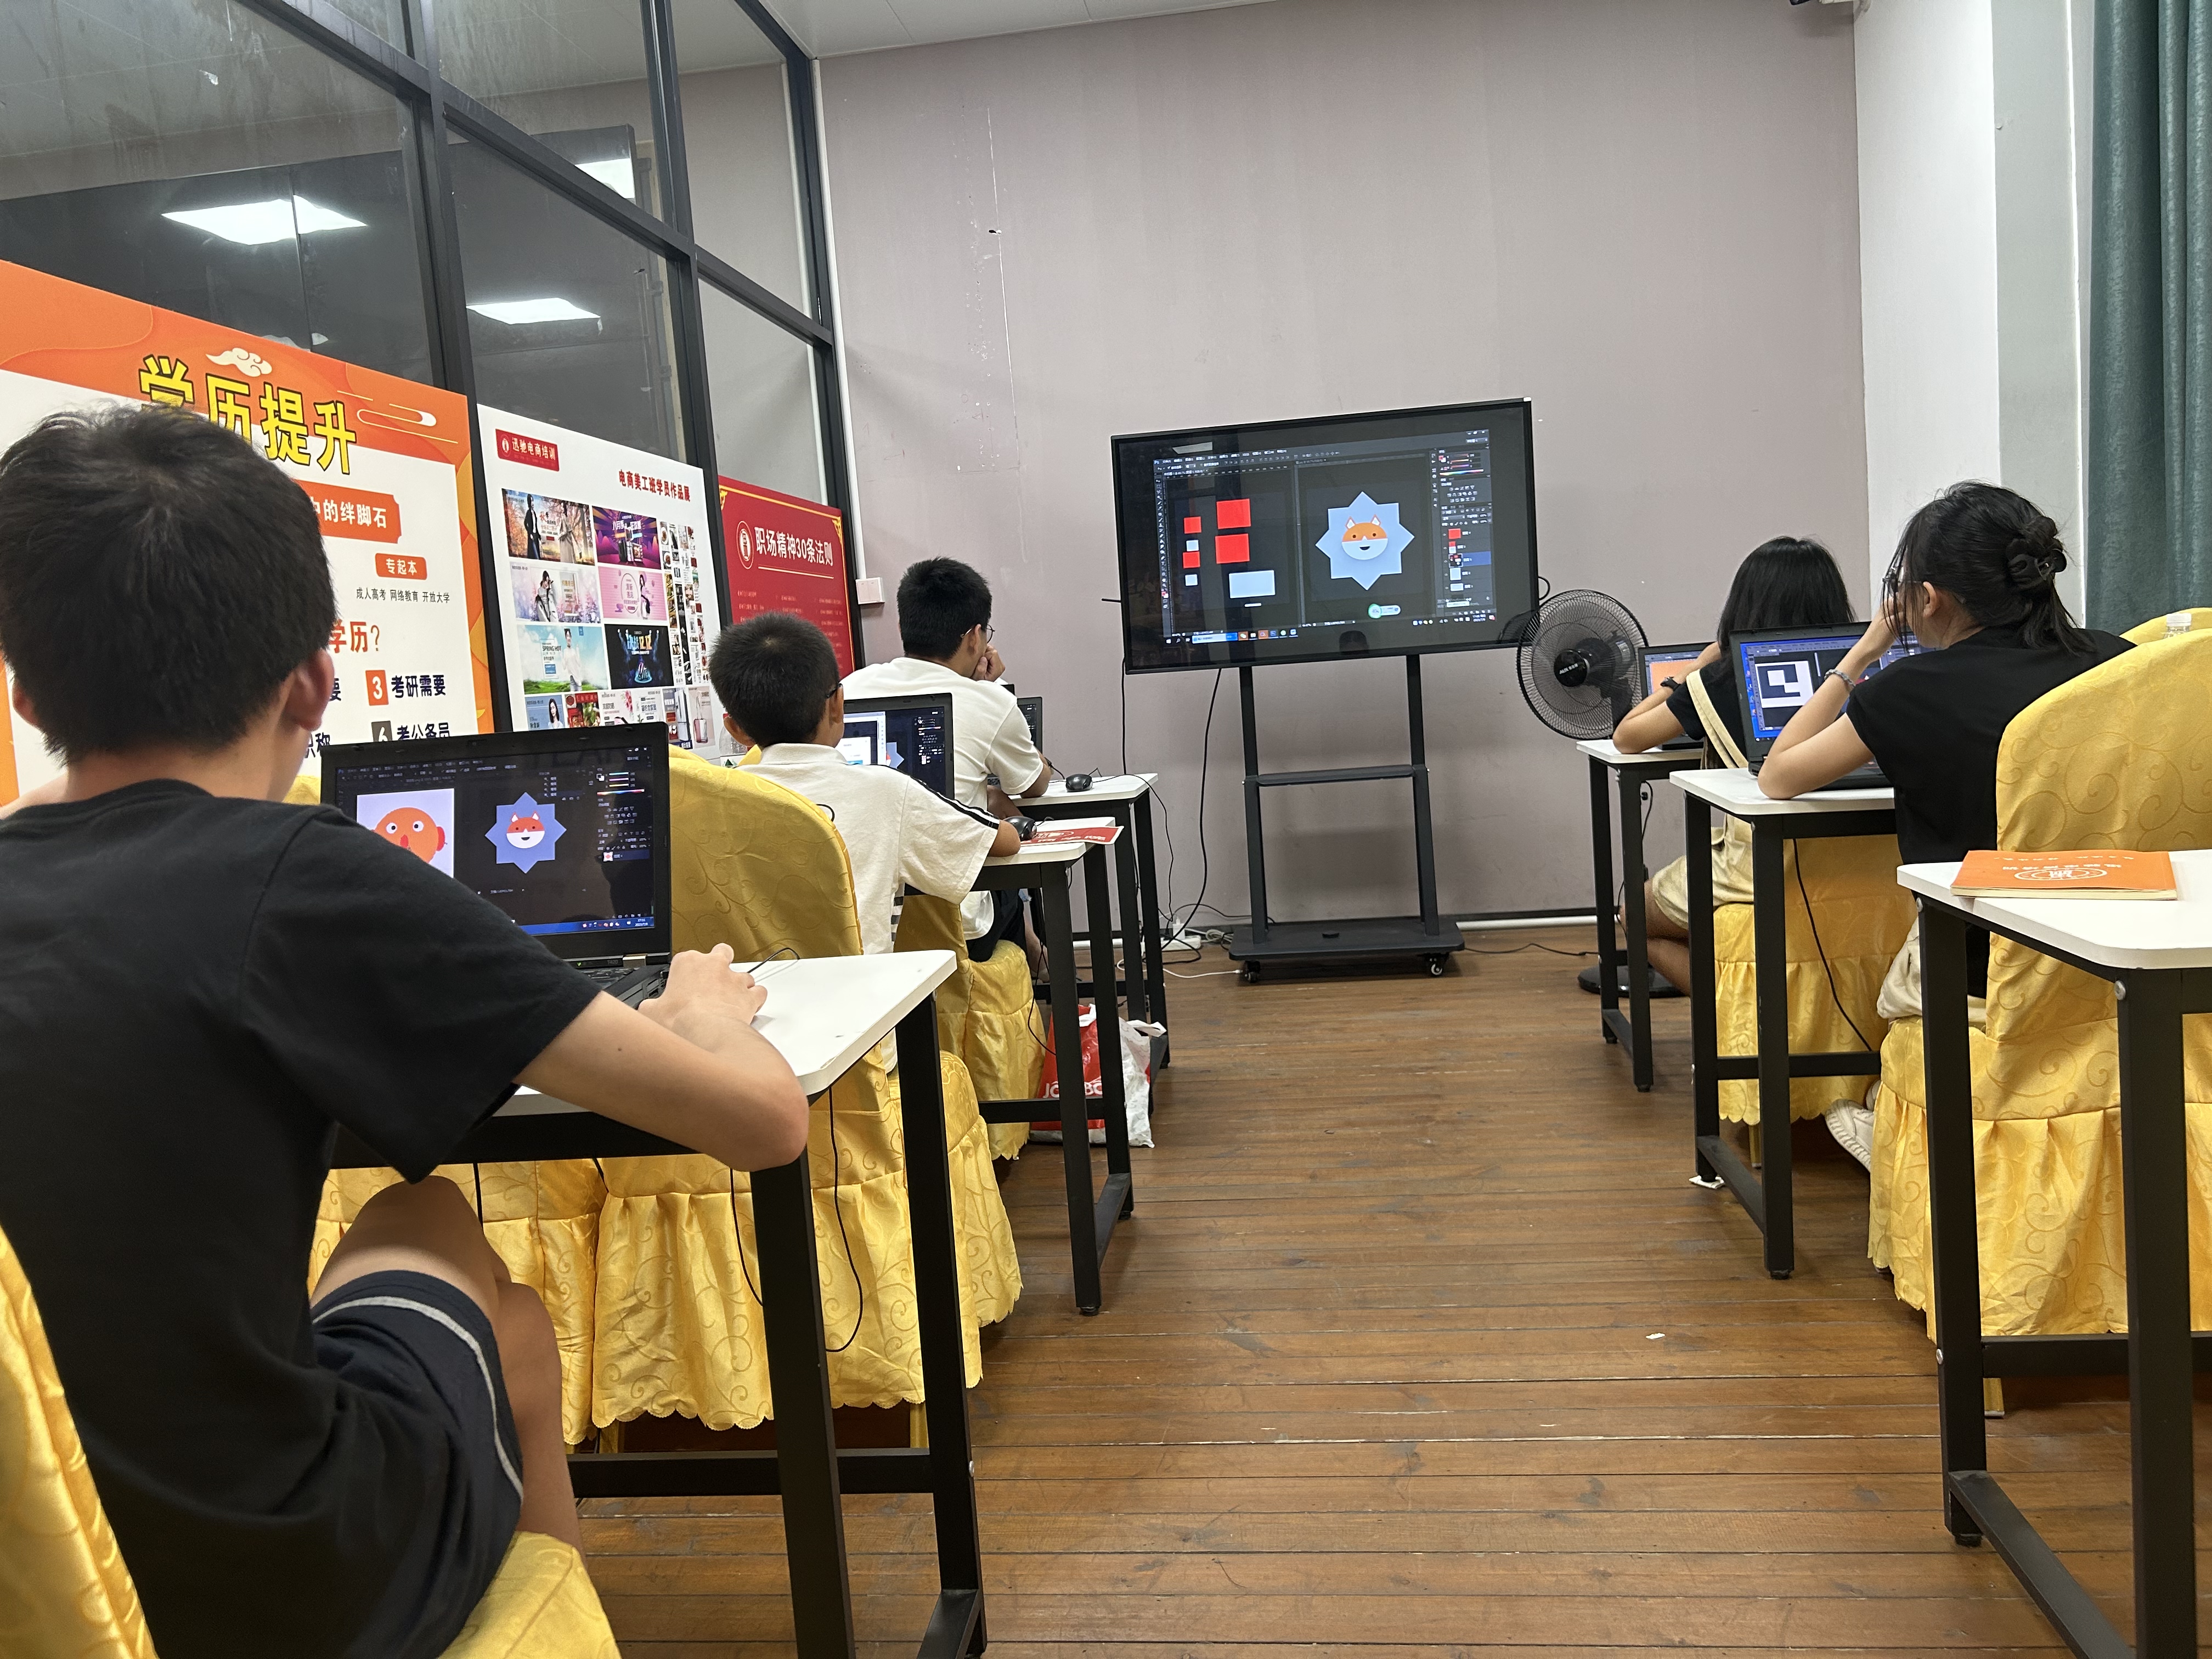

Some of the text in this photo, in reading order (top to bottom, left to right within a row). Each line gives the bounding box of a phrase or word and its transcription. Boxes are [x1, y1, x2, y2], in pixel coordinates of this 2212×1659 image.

[138, 354, 357, 476] 学历提升
[618, 469, 691, 503] 电商美工班学员作品展
[754, 526, 833, 567] 职场精神30条法则
[385, 557, 419, 576] 专起本
[356, 586, 450, 604] 成人高考 网络教育 开放大学
[373, 675, 446, 699] 3 考研需要
